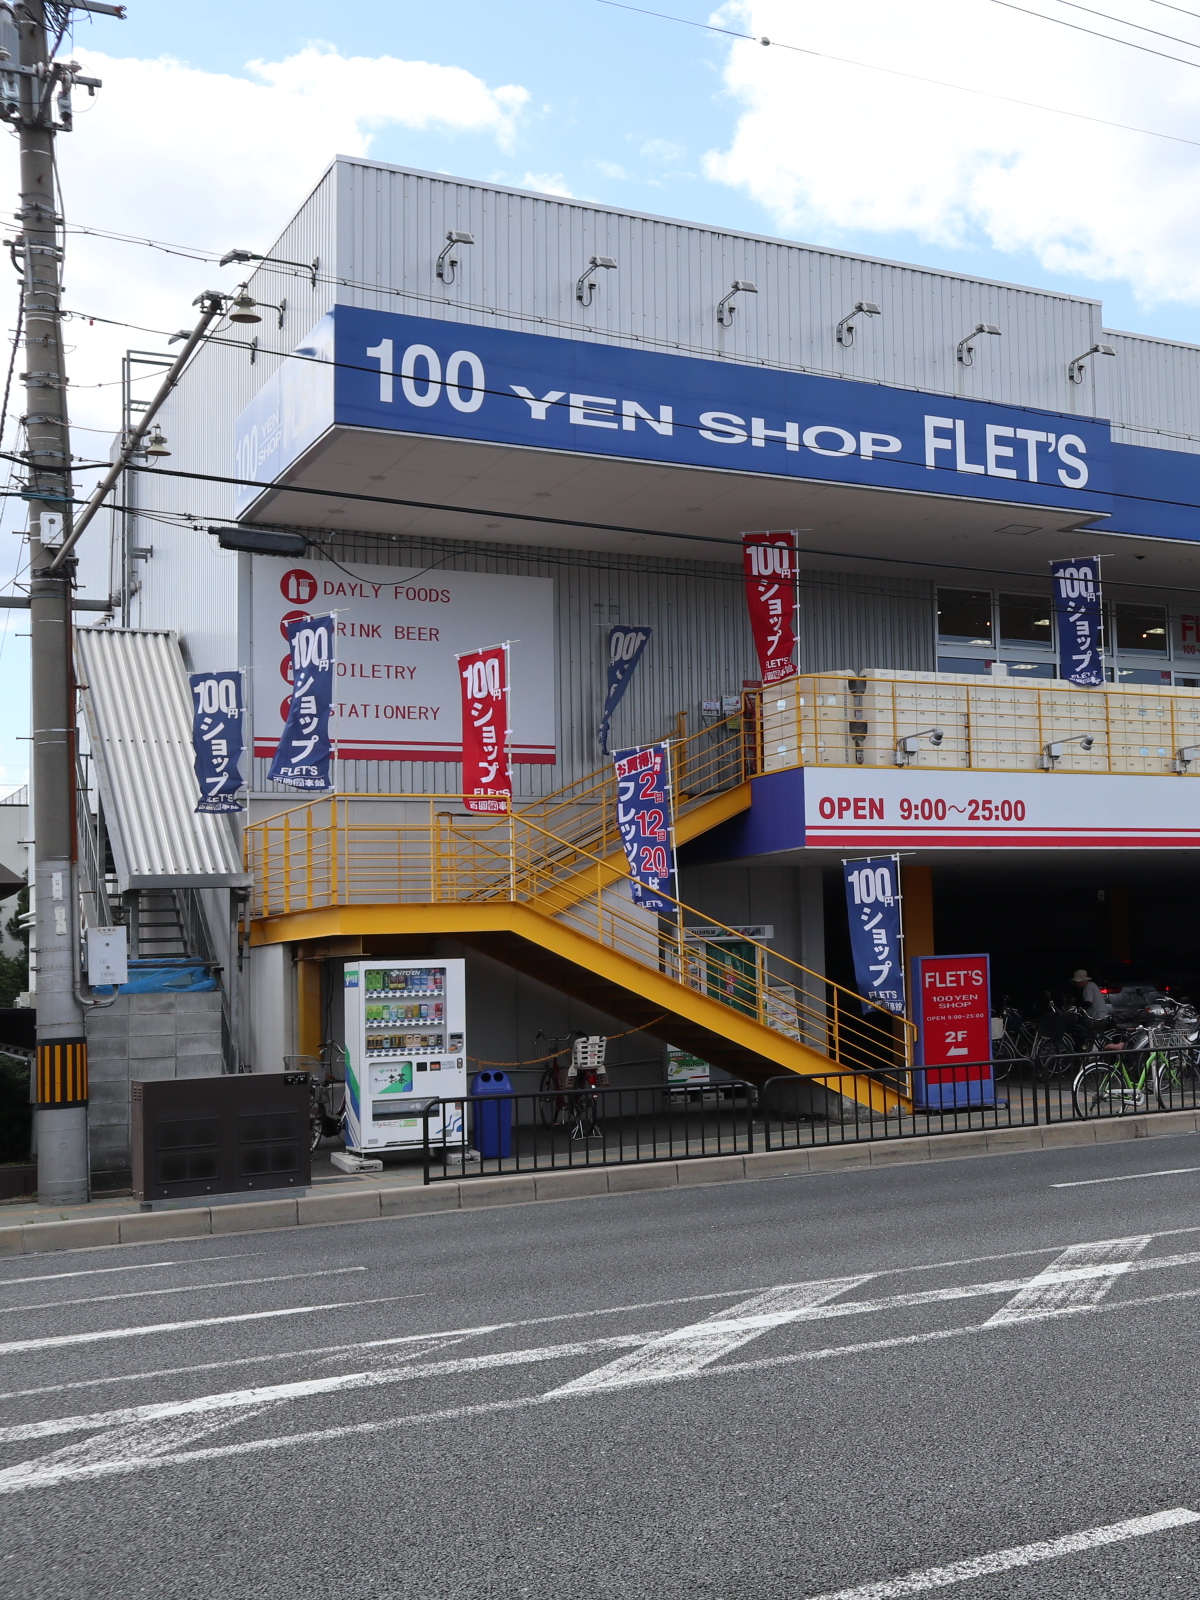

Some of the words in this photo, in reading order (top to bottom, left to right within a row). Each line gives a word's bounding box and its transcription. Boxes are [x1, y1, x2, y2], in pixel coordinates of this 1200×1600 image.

[261, 409, 280, 439] YEN
[366, 338, 486, 413] 100
[508, 384, 674, 436] YEN
[698, 411, 903, 461] SHOP
[924, 414, 1090, 489] FLET'S
[236, 424, 259, 496] 100
[258, 430, 282, 466] SHOP
[323, 581, 382, 598] DAYLY
[394, 586, 451, 603] FOODS
[757, 579, 783, 657] ショップ
[332, 622, 382, 639] RINK
[394, 625, 440, 642] BEER
[1066, 600, 1093, 672] ショップ
[1182, 644, 1196, 654] 100
[336, 662, 417, 680] OILETRY
[290, 672, 320, 764] ショップ
[471, 702, 500, 784] ショップ
[200, 717, 229, 797] ショップ
[279, 765, 318, 776] FLET'S
[818, 796, 885, 820] OPEN
[860, 907, 893, 987] ショップ
[925, 969, 983, 988] FLET'S
[931, 995, 954, 1003] 100
[938, 1001, 972, 1009] SHOP
[944, 1030, 968, 1043] 2F
